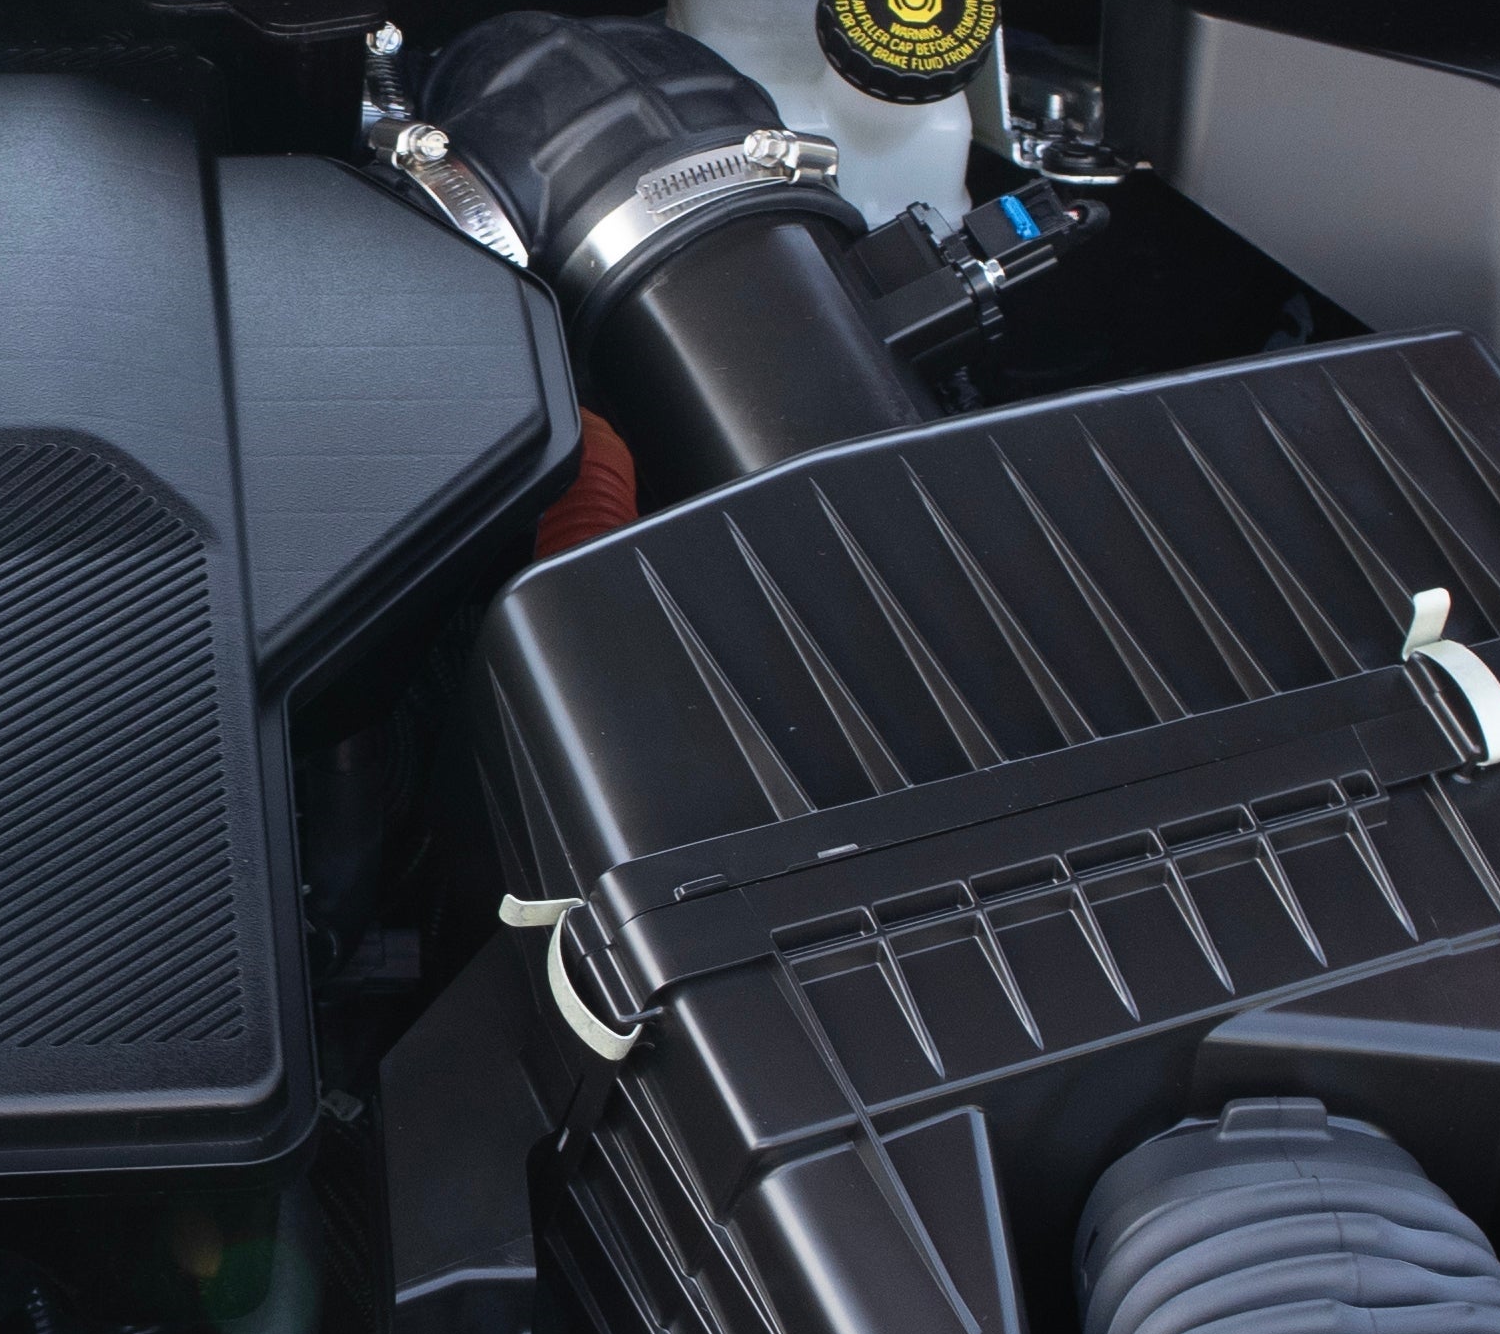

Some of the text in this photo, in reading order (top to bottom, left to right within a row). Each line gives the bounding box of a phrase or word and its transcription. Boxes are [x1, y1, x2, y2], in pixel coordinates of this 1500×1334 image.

[839, 12, 856, 30] OR
[889, 22, 943, 41] WARNING
[973, 5, 996, 40] SEALED
[848, 26, 874, 52] DOT4
[858, 14, 891, 45] FILLER
[890, 38, 914, 54] CAP
[915, 34, 959, 56] BEFORE
[968, 38, 981, 50] A
[872, 46, 909, 69] BRAKE
[911, 56, 944, 71] FLUID
[944, 43, 974, 65] FROM
